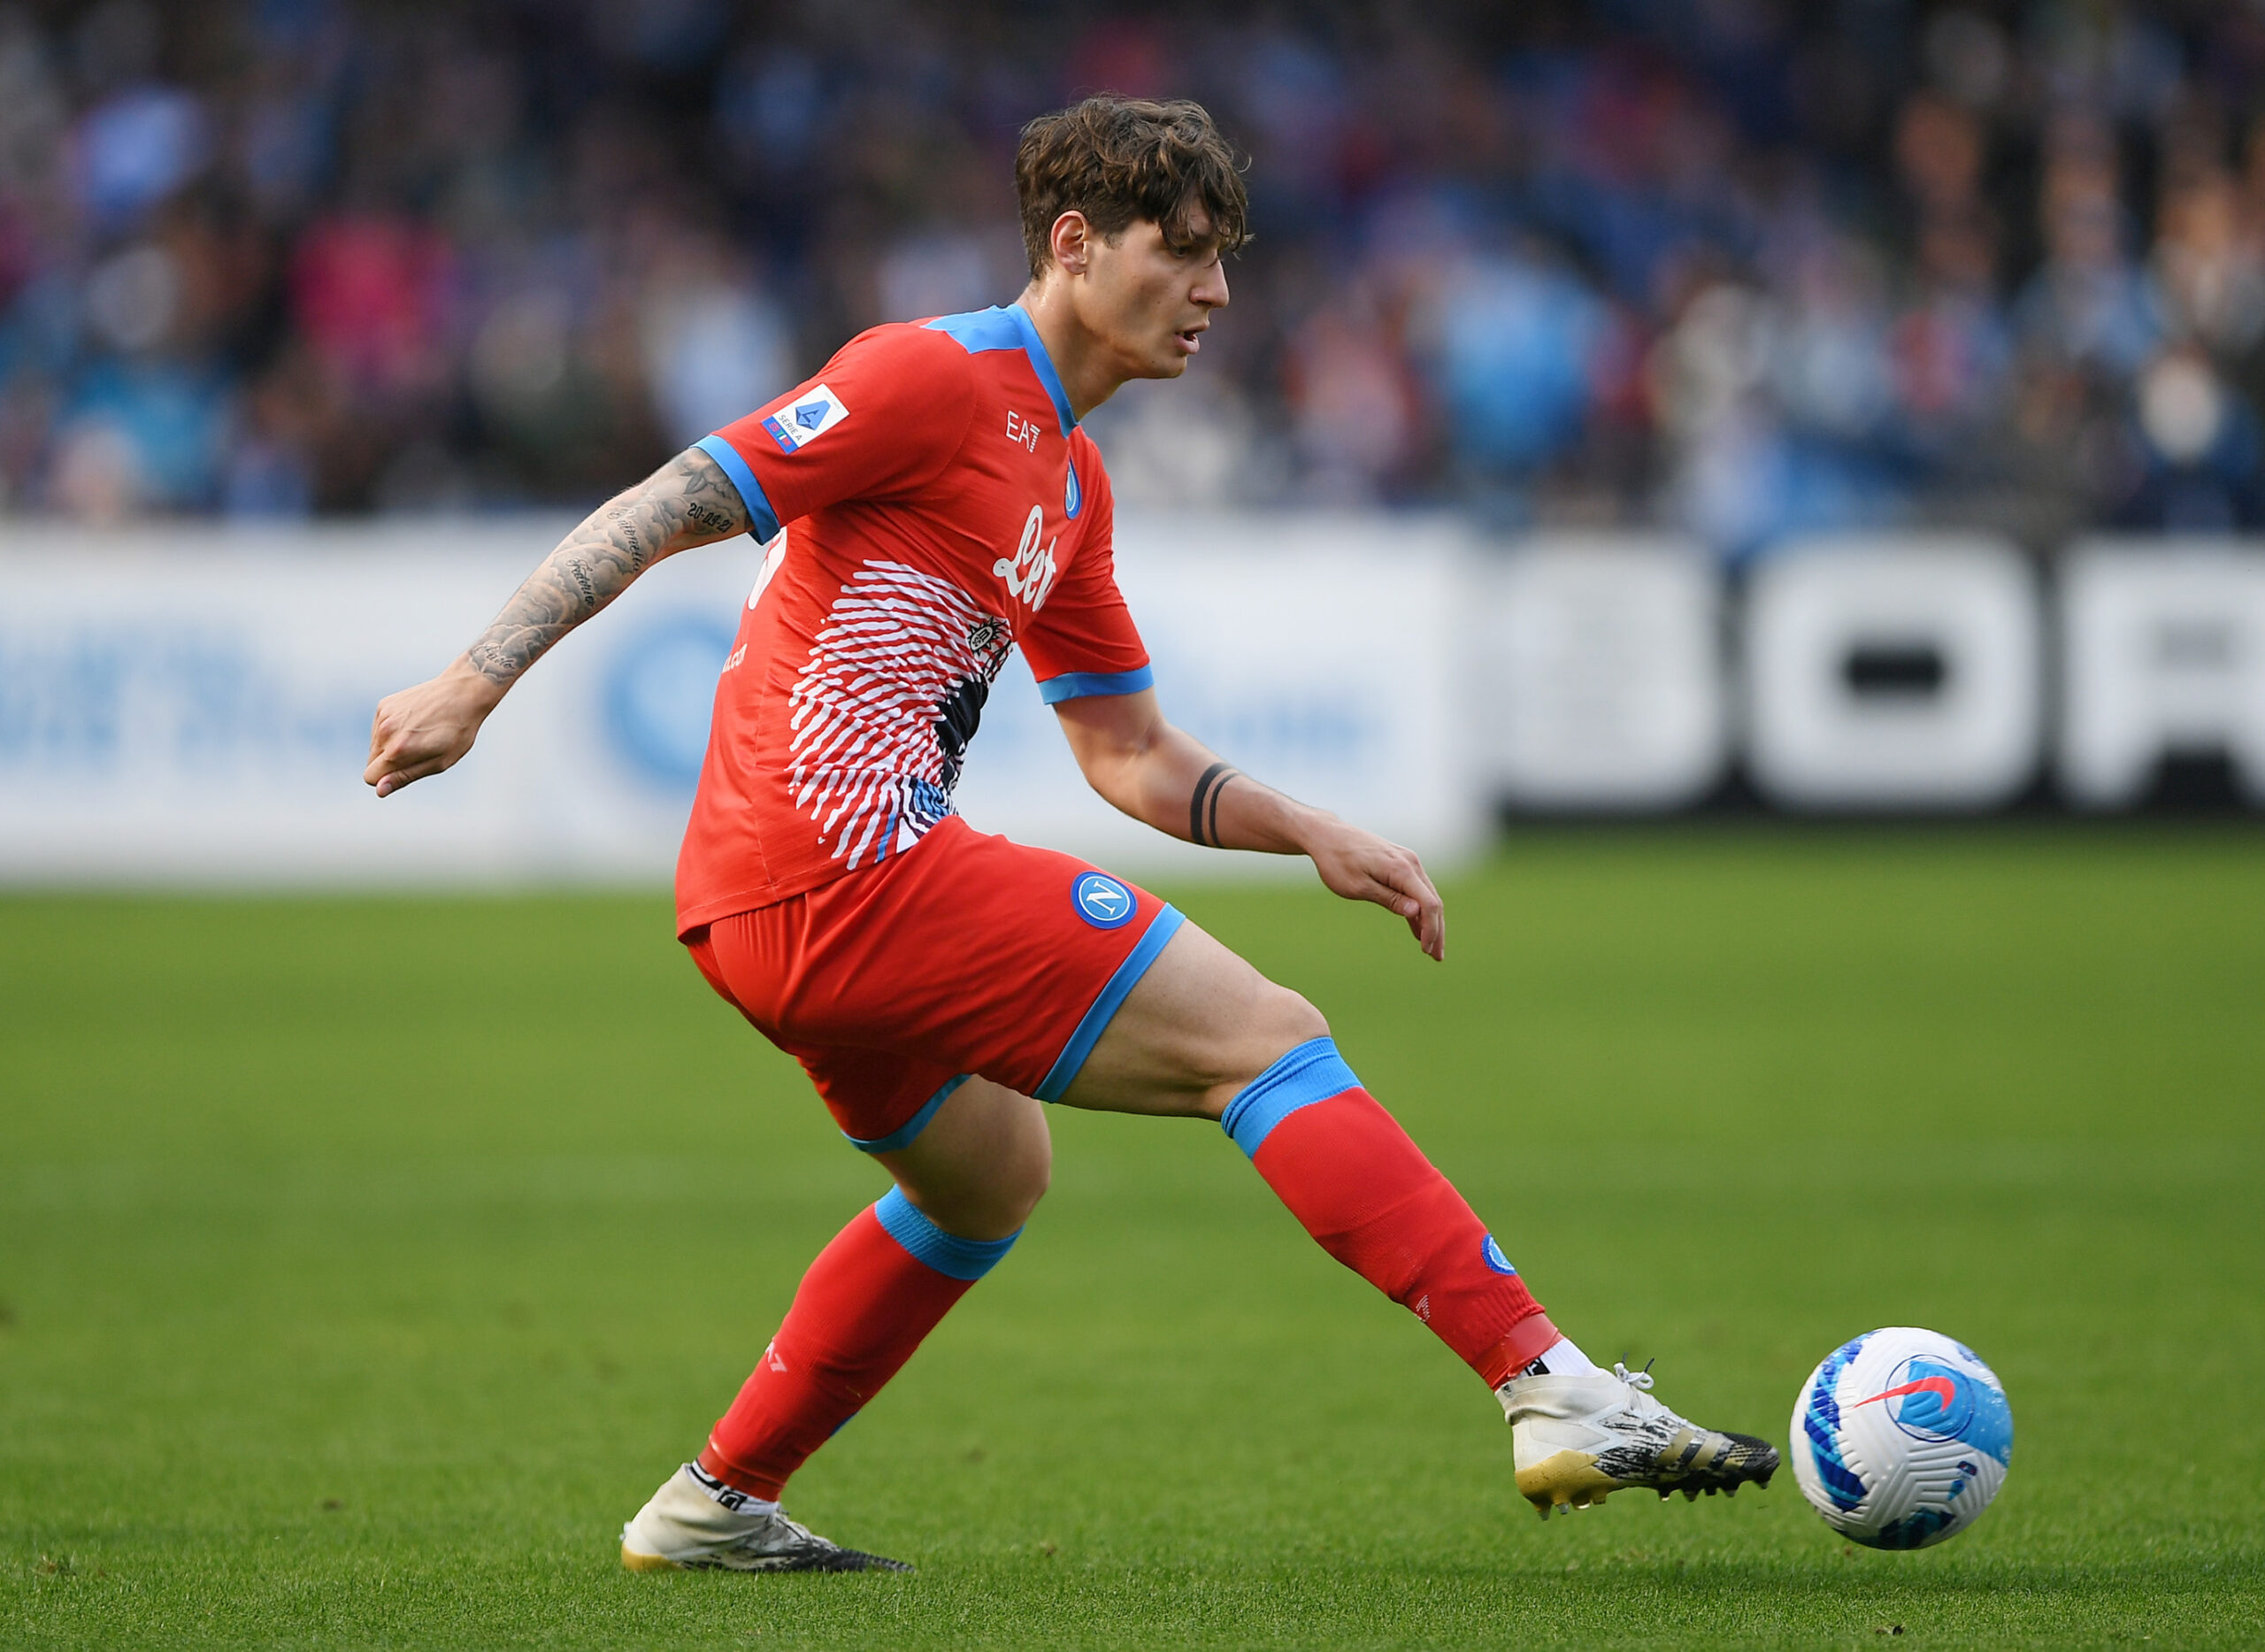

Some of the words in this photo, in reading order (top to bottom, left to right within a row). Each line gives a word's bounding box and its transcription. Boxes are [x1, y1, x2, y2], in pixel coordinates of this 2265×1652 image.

[779, 414, 799, 435] SERIE
[992, 503, 1058, 612] Let
[1086, 880, 1123, 916] N
